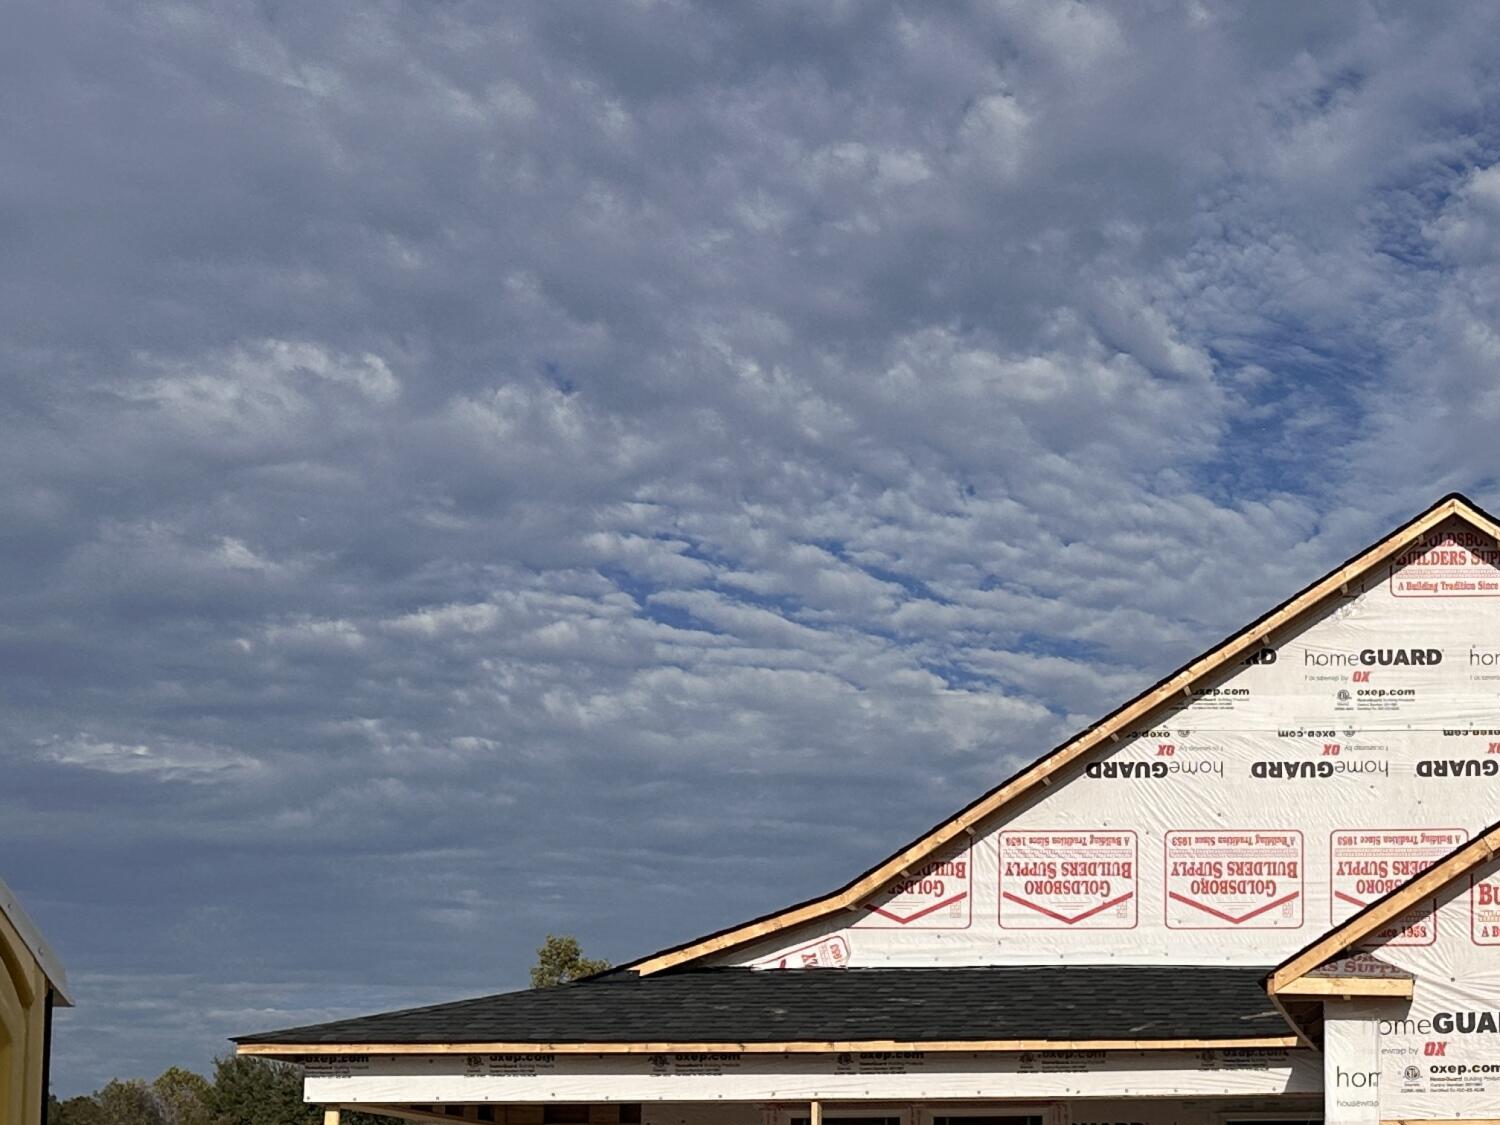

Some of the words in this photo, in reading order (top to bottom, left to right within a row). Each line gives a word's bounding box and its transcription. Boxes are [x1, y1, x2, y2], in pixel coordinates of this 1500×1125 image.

[1398, 582, 1404, 591] A
[1406, 581, 1438, 593] Building
[1441, 581, 1476, 591] Tradition
[1478, 581, 1498, 591] Since
[1304, 648, 1443, 666] homeGUARD
[1352, 670, 1371, 682] OX
[1356, 687, 1416, 697] oxep.com
[1155, 744, 1175, 756] OX
[1322, 743, 1341, 756] OX
[1086, 760, 1224, 779] homeGUARD
[1251, 759, 1389, 778] homeGUARD
[1004, 861, 1057, 879] SUPPLY
[1061, 861, 1132, 879] BUILDERS
[1171, 861, 1223, 879] SUPPLY
[1227, 861, 1298, 879] BUILDERS
[1336, 861, 1388, 878] SUPPLY
[1024, 880, 1111, 898] GOLDSBORO
[1190, 880, 1277, 897] GOLDSBORO
[1481, 926, 1489, 937] A
[1423, 1041, 1448, 1057] OX
